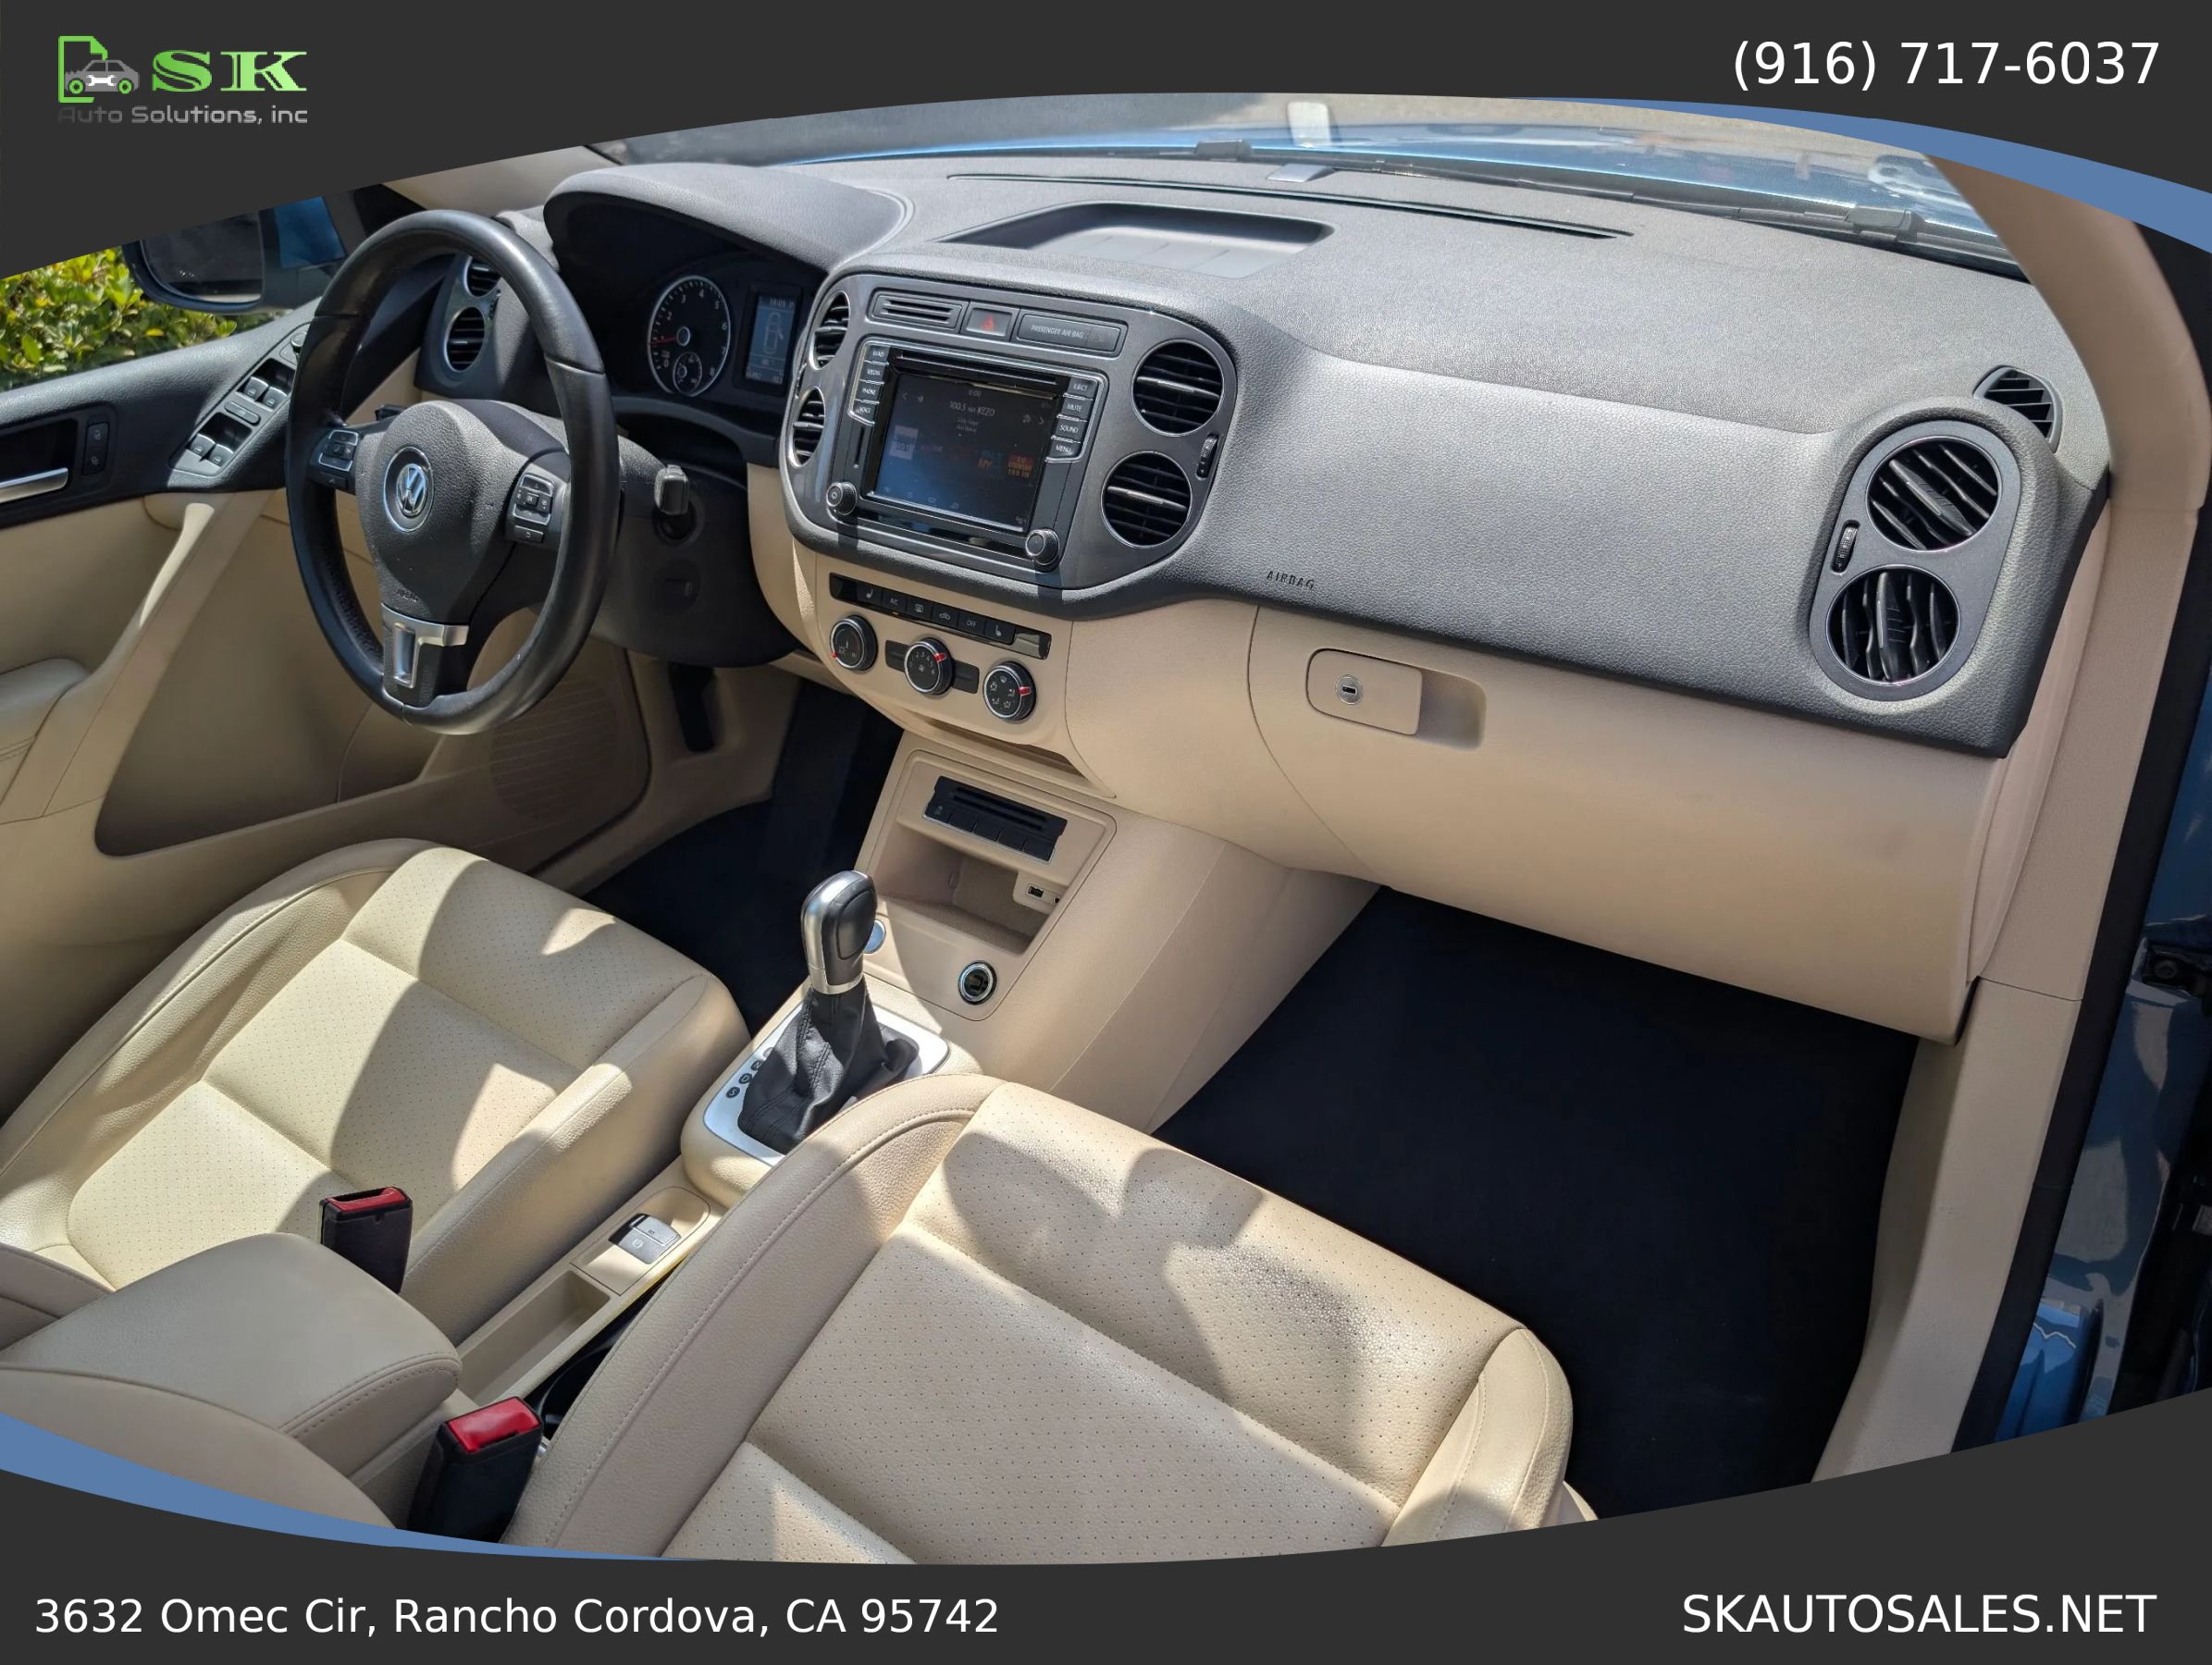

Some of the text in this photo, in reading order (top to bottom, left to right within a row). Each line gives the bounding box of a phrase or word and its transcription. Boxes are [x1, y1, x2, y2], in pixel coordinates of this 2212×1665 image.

[1031, 325, 1061, 335] PASSENGER
[1061, 328, 1072, 337] AIR
[1071, 331, 1085, 339] BAG
[1067, 403, 1083, 413] MUTE
[1059, 424, 1080, 434] SOUND
[1056, 444, 1073, 453] MENU
[1267, 570, 1315, 591] AIRBAG
[966, 620, 977, 628] OFF
